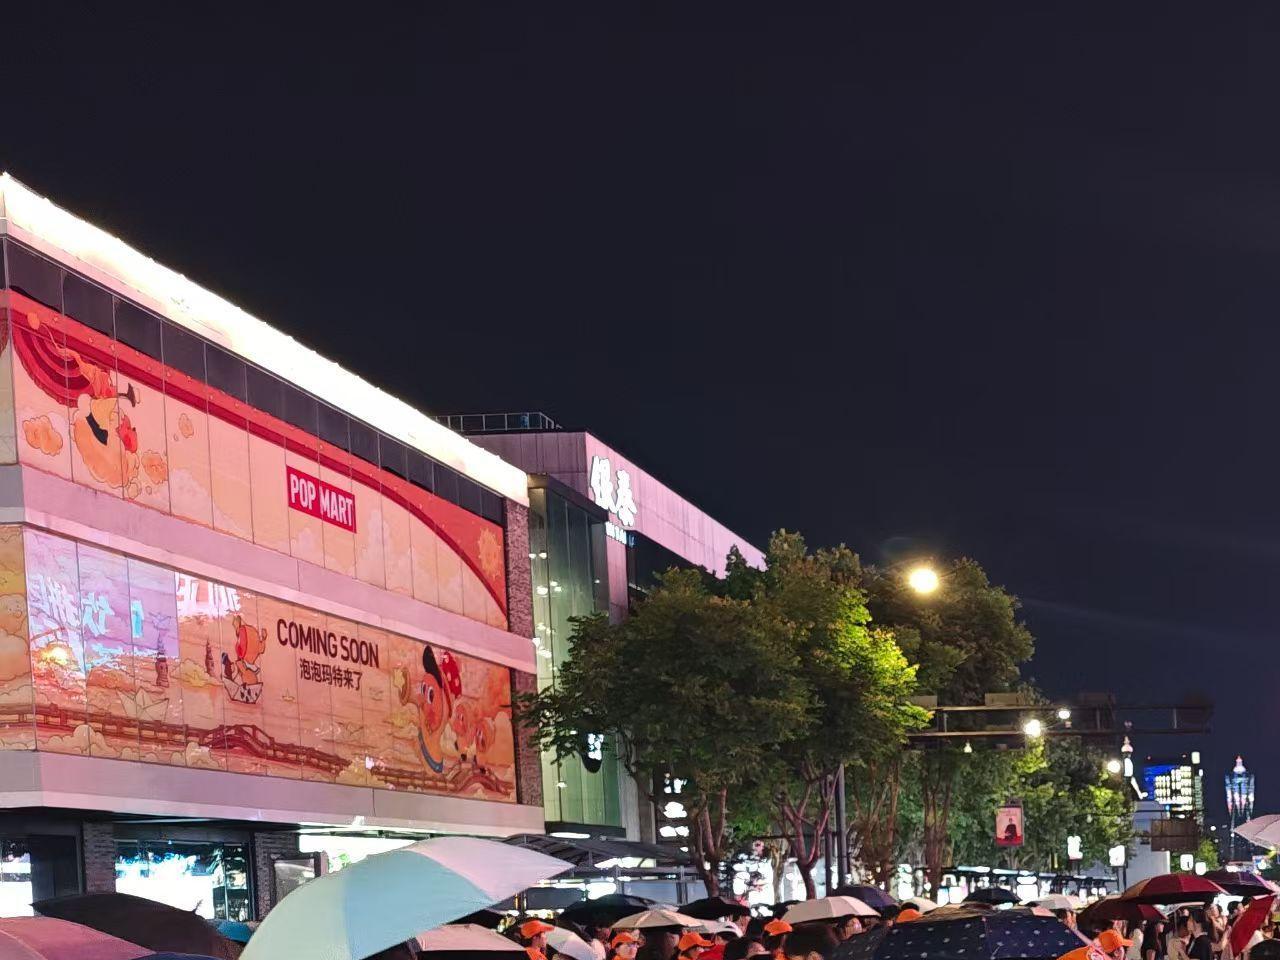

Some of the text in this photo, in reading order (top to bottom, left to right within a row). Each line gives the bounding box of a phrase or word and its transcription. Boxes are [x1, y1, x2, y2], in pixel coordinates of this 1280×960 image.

[290, 473, 353, 527] POP MART
[277, 618, 380, 669] COMING SOON
[299, 658, 363, 691] 泡泡玛特来了
